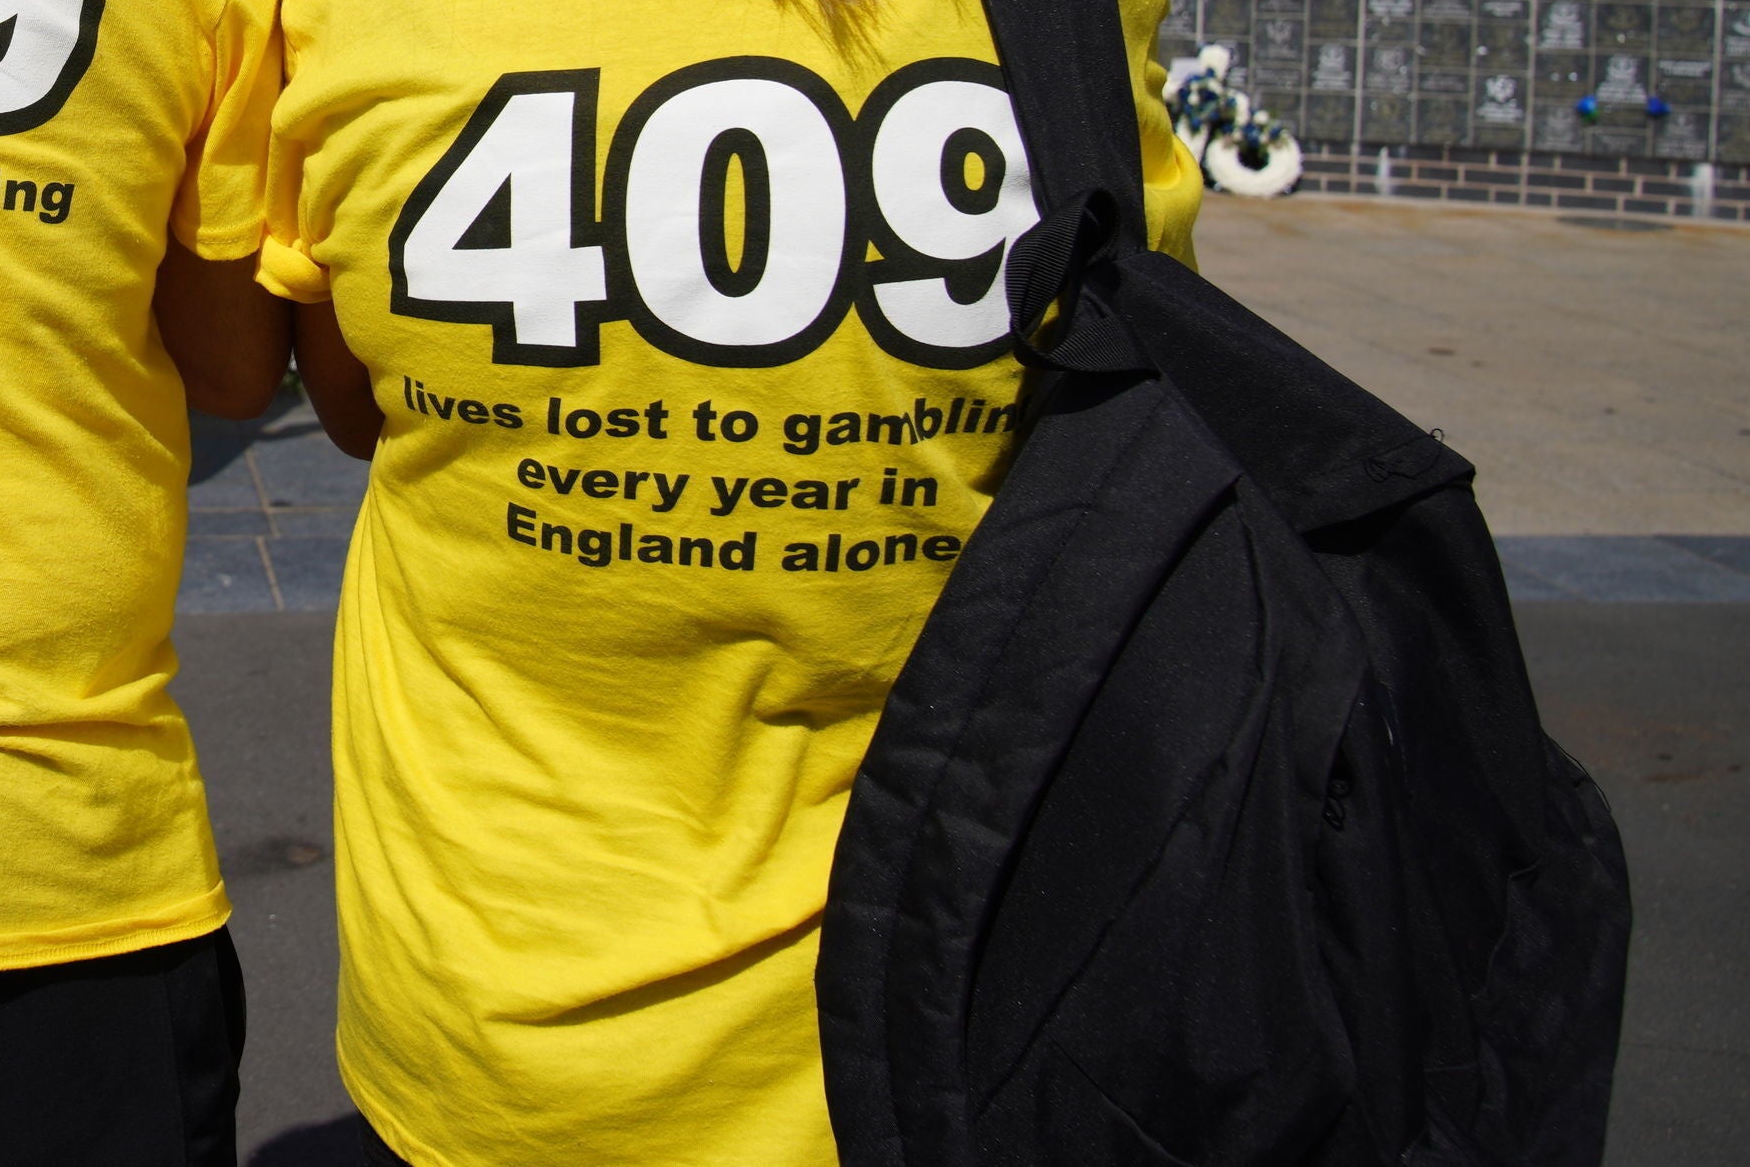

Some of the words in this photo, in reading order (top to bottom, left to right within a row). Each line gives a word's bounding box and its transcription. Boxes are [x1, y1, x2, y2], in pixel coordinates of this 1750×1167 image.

[388, 55, 1042, 370] 409
[403, 375, 524, 429] lives
[547, 397, 670, 439] lost
[692, 399, 759, 441] to
[516, 457, 689, 514] every
[709, 475, 861, 518] year
[879, 468, 938, 508] in
[506, 501, 756, 572] England
[782, 532, 962, 573] alone
